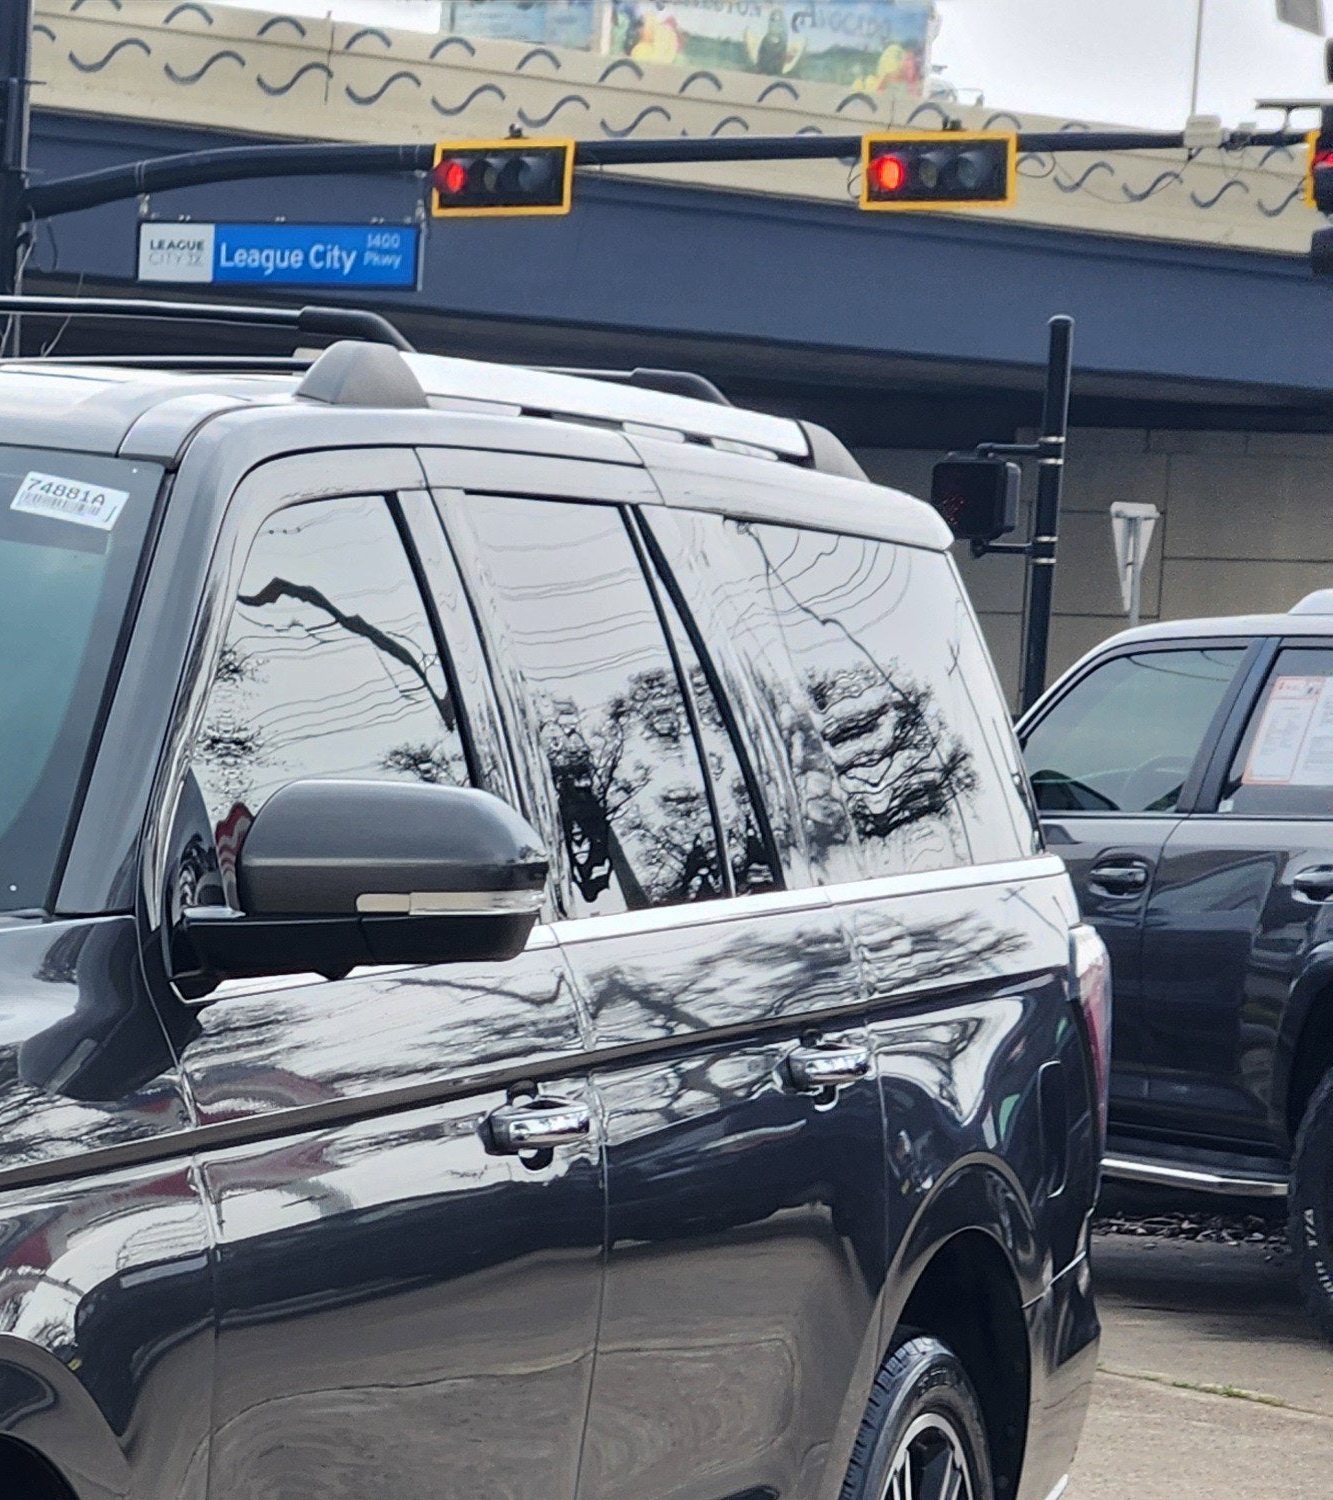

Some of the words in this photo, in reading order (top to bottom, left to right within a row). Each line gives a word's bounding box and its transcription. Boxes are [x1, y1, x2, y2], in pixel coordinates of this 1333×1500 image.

[149, 239, 205, 251] LEAGUE
[367, 232, 401, 249] 1400
[219, 242, 304, 276] League
[308, 243, 358, 276] City
[363, 249, 402, 271] Pkwy
[26, 477, 107, 508] 74881A
